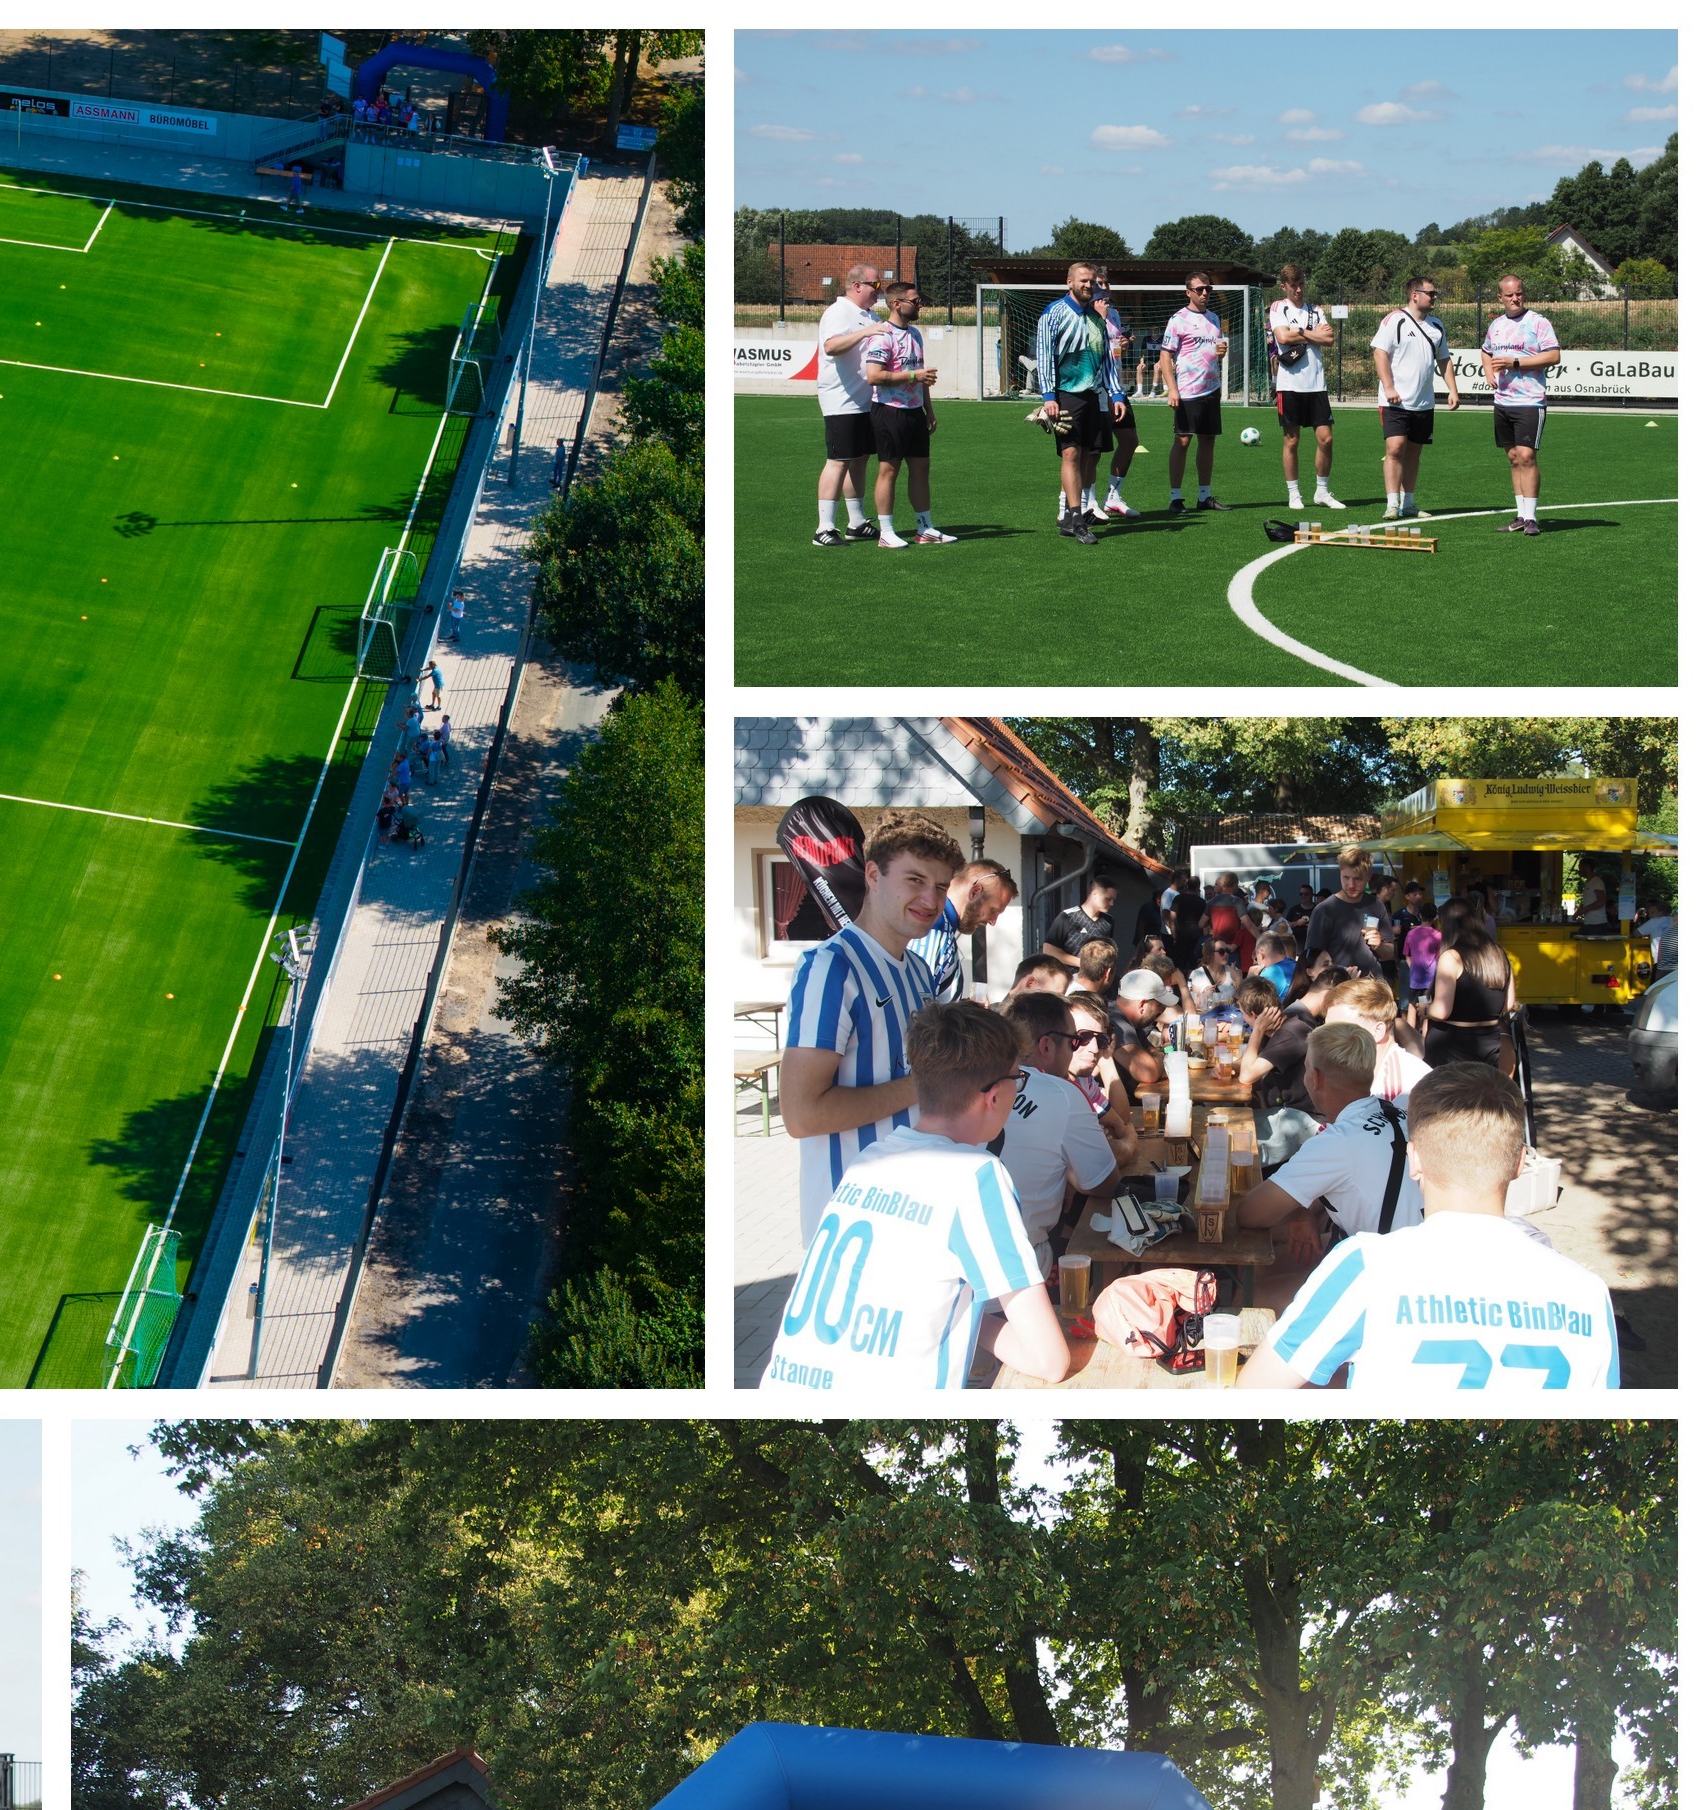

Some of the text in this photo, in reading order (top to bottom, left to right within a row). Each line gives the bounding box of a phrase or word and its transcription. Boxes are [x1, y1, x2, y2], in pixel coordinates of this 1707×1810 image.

[12, 98, 55, 111] melos
[76, 105, 211, 131] ASSMANN BÜROMÖBEL
[1590, 361, 1675, 378] GaLaBau
[1554, 383, 1631, 394] aus Osnabrück
[861, 1186, 935, 1227] BinBlau
[1395, 1294, 1593, 1337] Athletic BinBlau
[850, 1304, 904, 1358] CM
[770, 1355, 834, 1389] Stange
